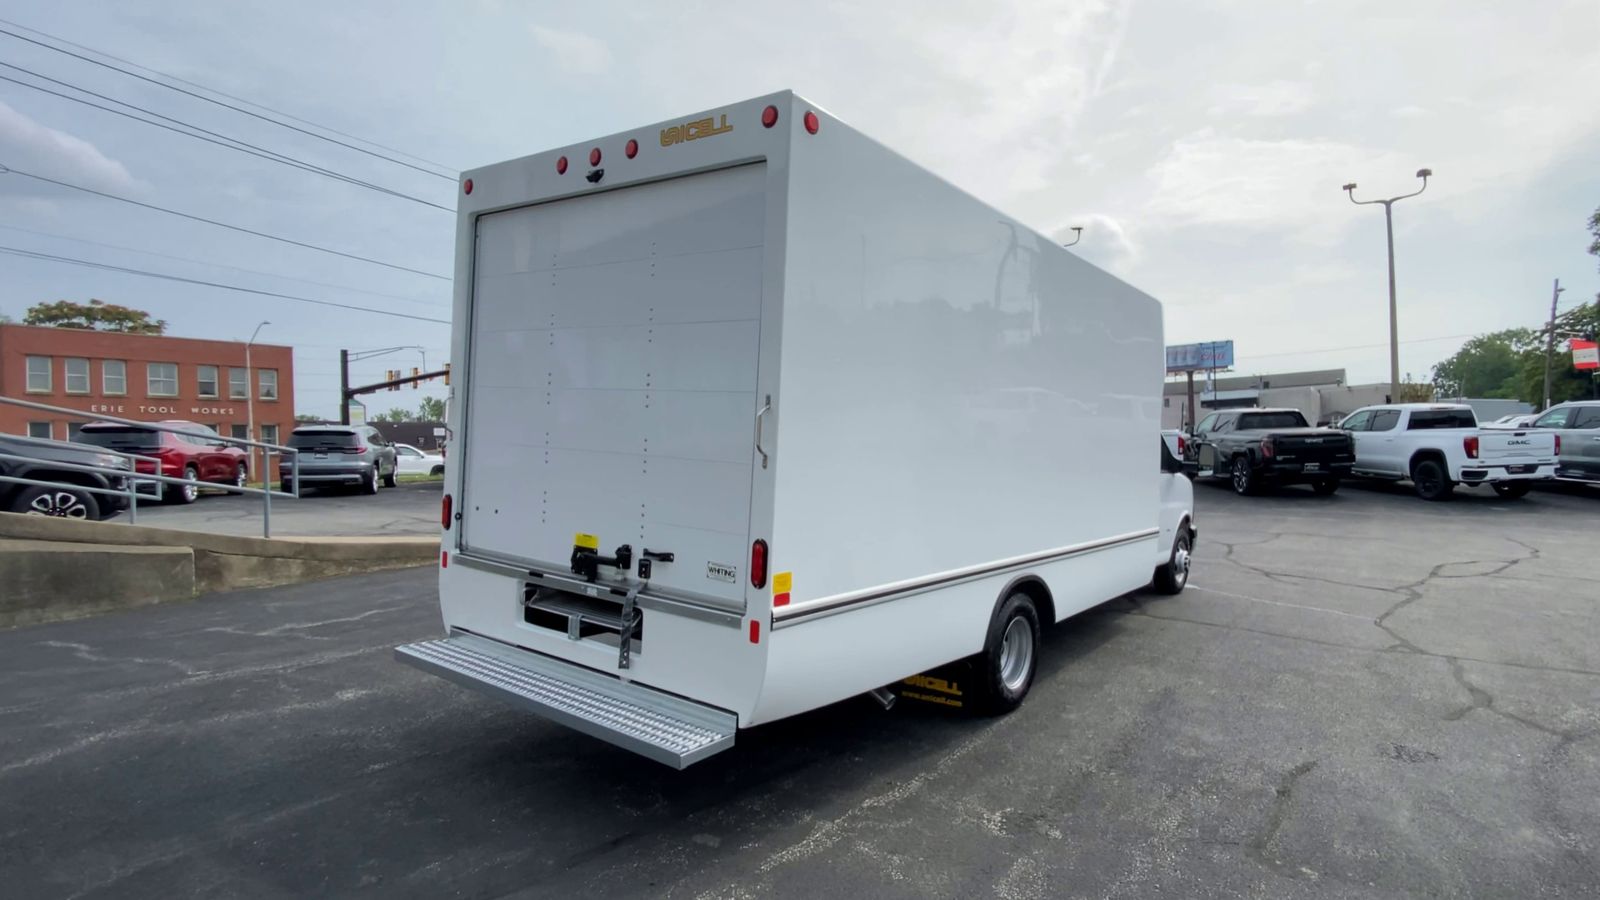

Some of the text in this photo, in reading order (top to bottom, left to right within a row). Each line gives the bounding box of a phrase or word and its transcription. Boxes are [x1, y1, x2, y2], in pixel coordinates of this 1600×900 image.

[660, 114, 733, 147] UNICELL
[91, 404, 235, 415] ERIE TOOL WORKS
[708, 566, 736, 578] WHITING
